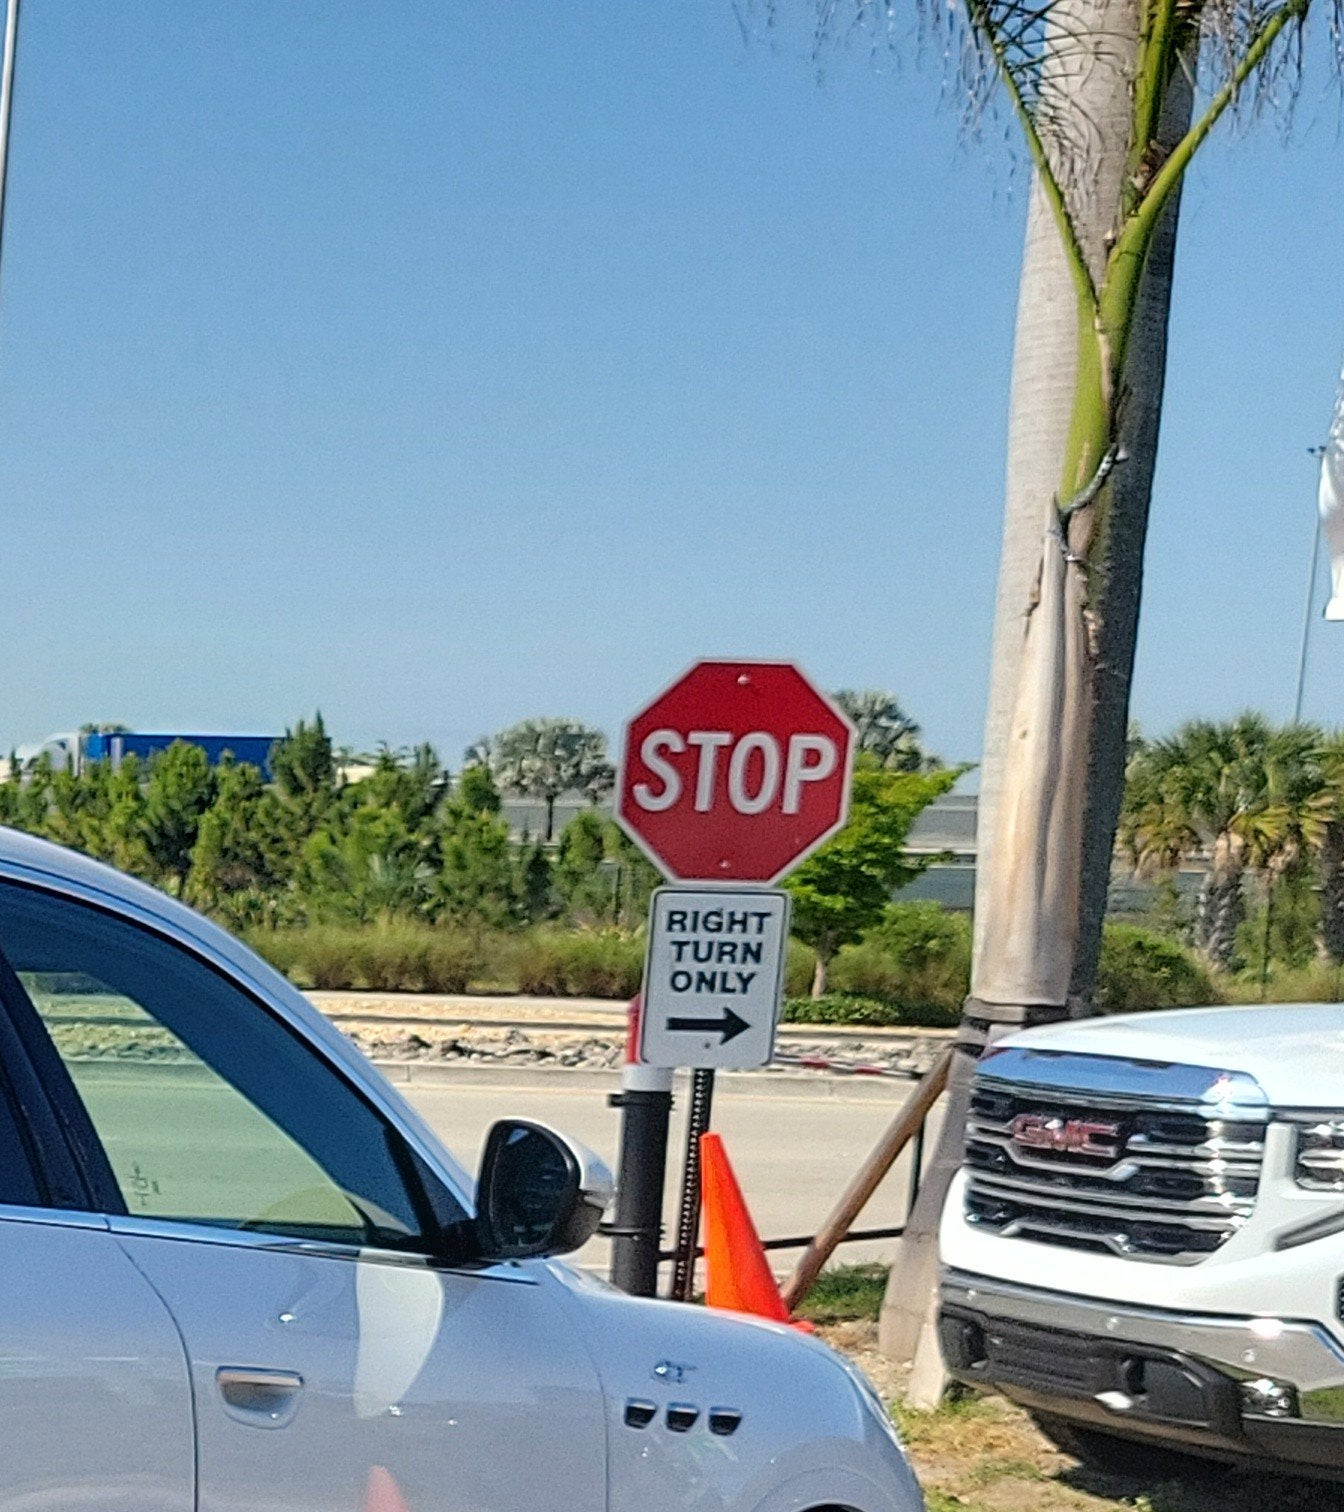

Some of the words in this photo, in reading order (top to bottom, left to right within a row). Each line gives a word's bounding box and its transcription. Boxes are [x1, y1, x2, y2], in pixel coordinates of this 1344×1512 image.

[632, 729, 839, 815] STOP
[665, 909, 772, 934] RIGHT
[670, 940, 762, 964] TURN
[669, 970, 756, 994] ONLY
[1011, 1114, 1118, 1158] GMC
